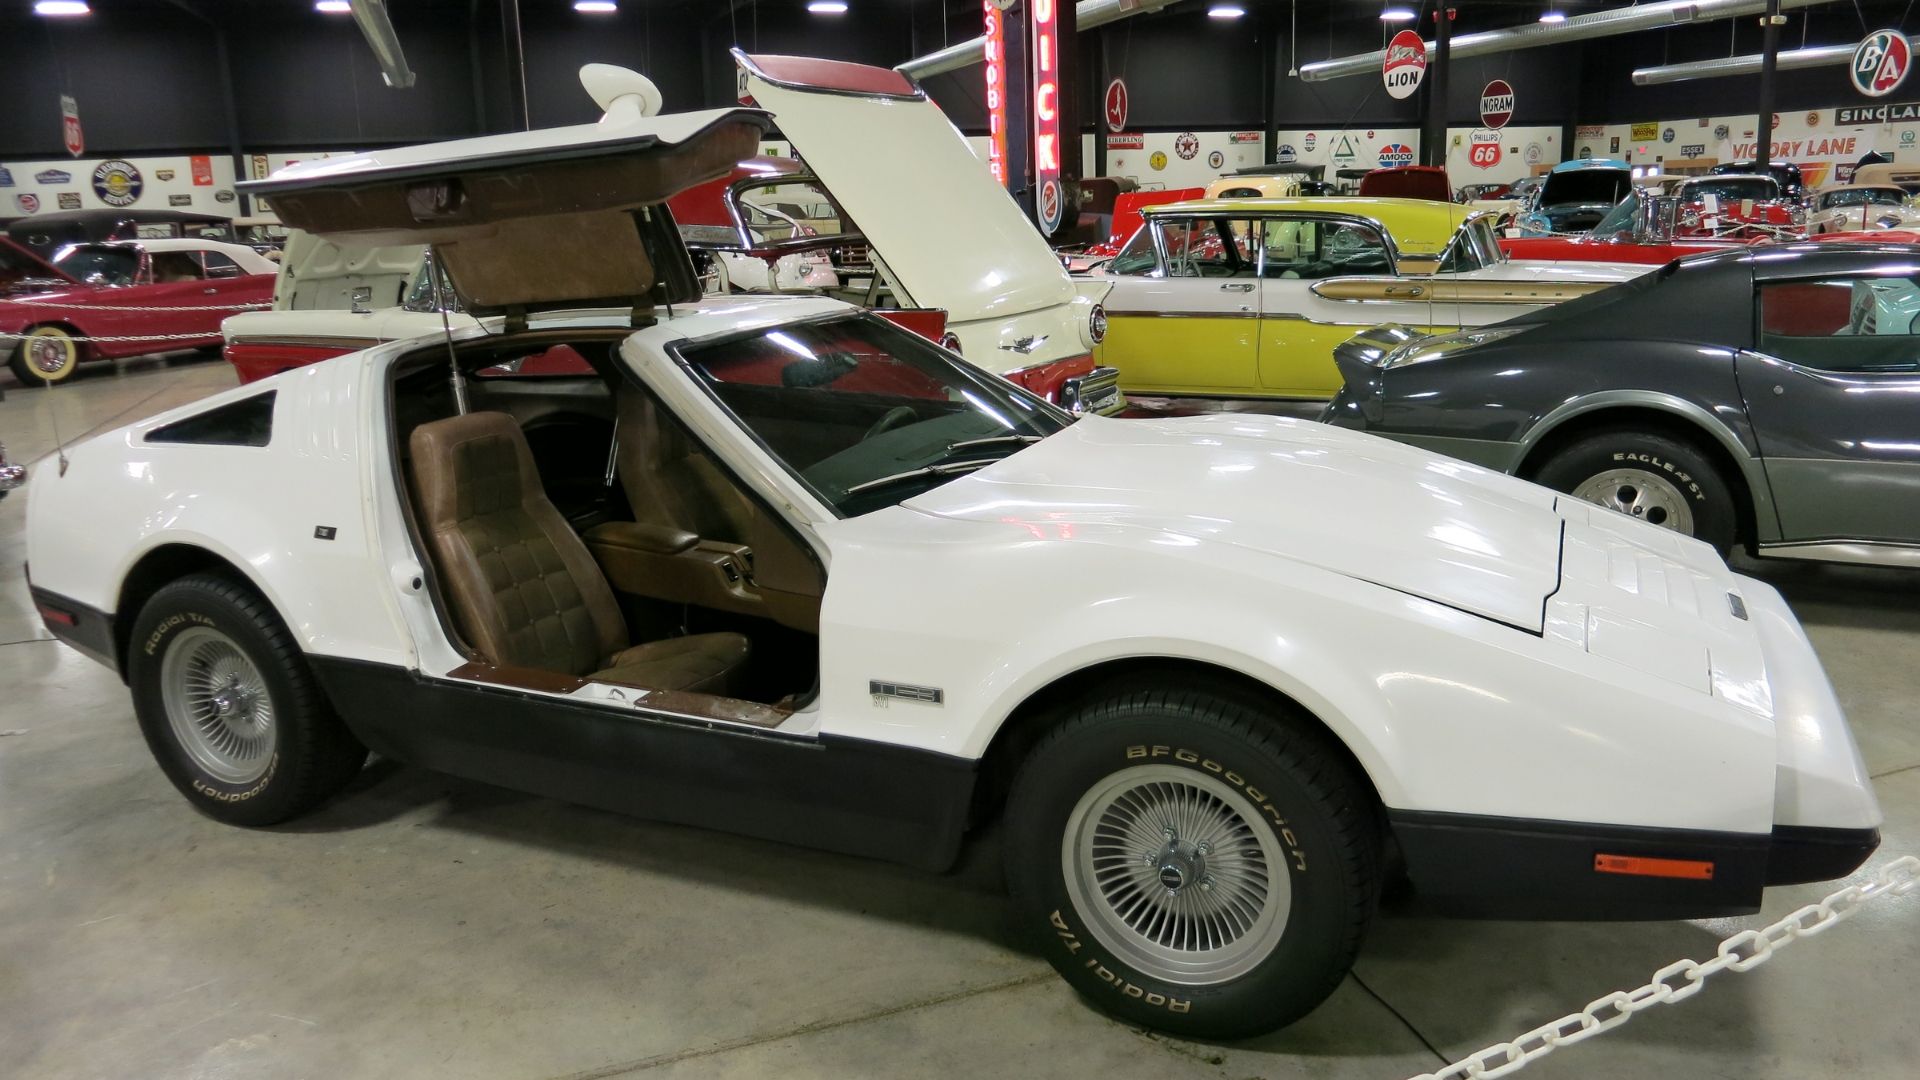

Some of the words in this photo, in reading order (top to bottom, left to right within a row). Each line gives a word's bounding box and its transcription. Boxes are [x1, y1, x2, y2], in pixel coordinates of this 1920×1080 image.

[1388, 71, 1419, 88] LION
[1474, 134, 1499, 142] PHILLIPS
[1378, 153, 1413, 161] AMOCO
[1474, 146, 1497, 163] 66
[1682, 145, 1704, 154] ESSEX
[1733, 142, 1803, 160] VICORY
[1807, 138, 1857, 157] LANE
[1613, 453, 1676, 473] EAGLE
[1126, 744, 1307, 872] BFGoodrich
[1085, 958, 1191, 1014] Radial
